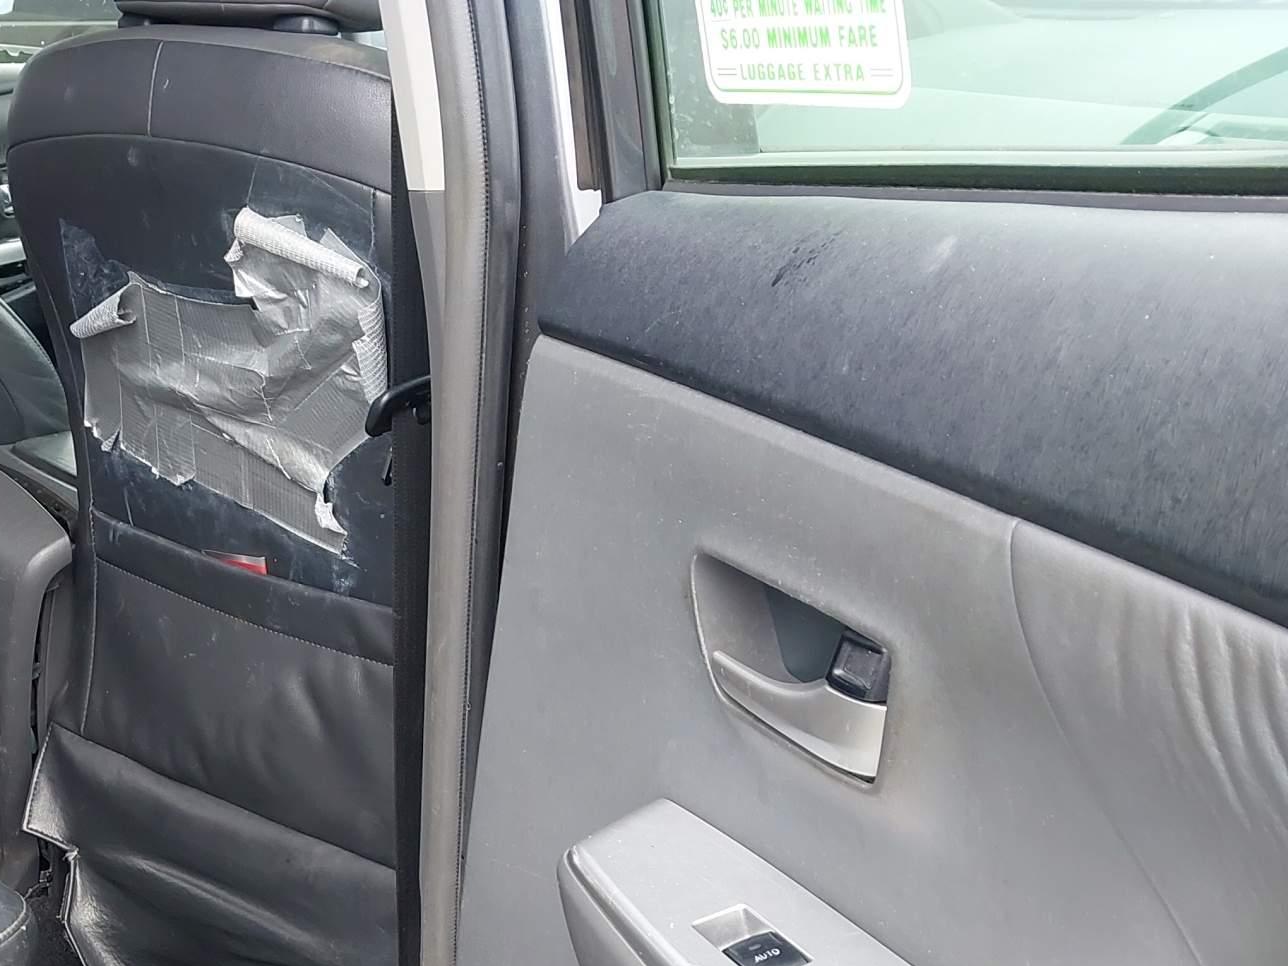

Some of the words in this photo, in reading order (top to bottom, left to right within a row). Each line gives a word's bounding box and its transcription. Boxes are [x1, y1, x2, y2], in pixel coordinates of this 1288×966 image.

[732, 0, 754, 19] PER
[758, 0, 799, 17] MINUTE
[803, 0, 853, 16] WAITING
[720, 27, 761, 50] $6.00
[766, 25, 831, 49] MINIMUM
[838, 24, 879, 48] FARE
[739, 63, 807, 81] LUGGAGE
[813, 63, 865, 82] EXTRA
[754, 948, 780, 963] AUTO
